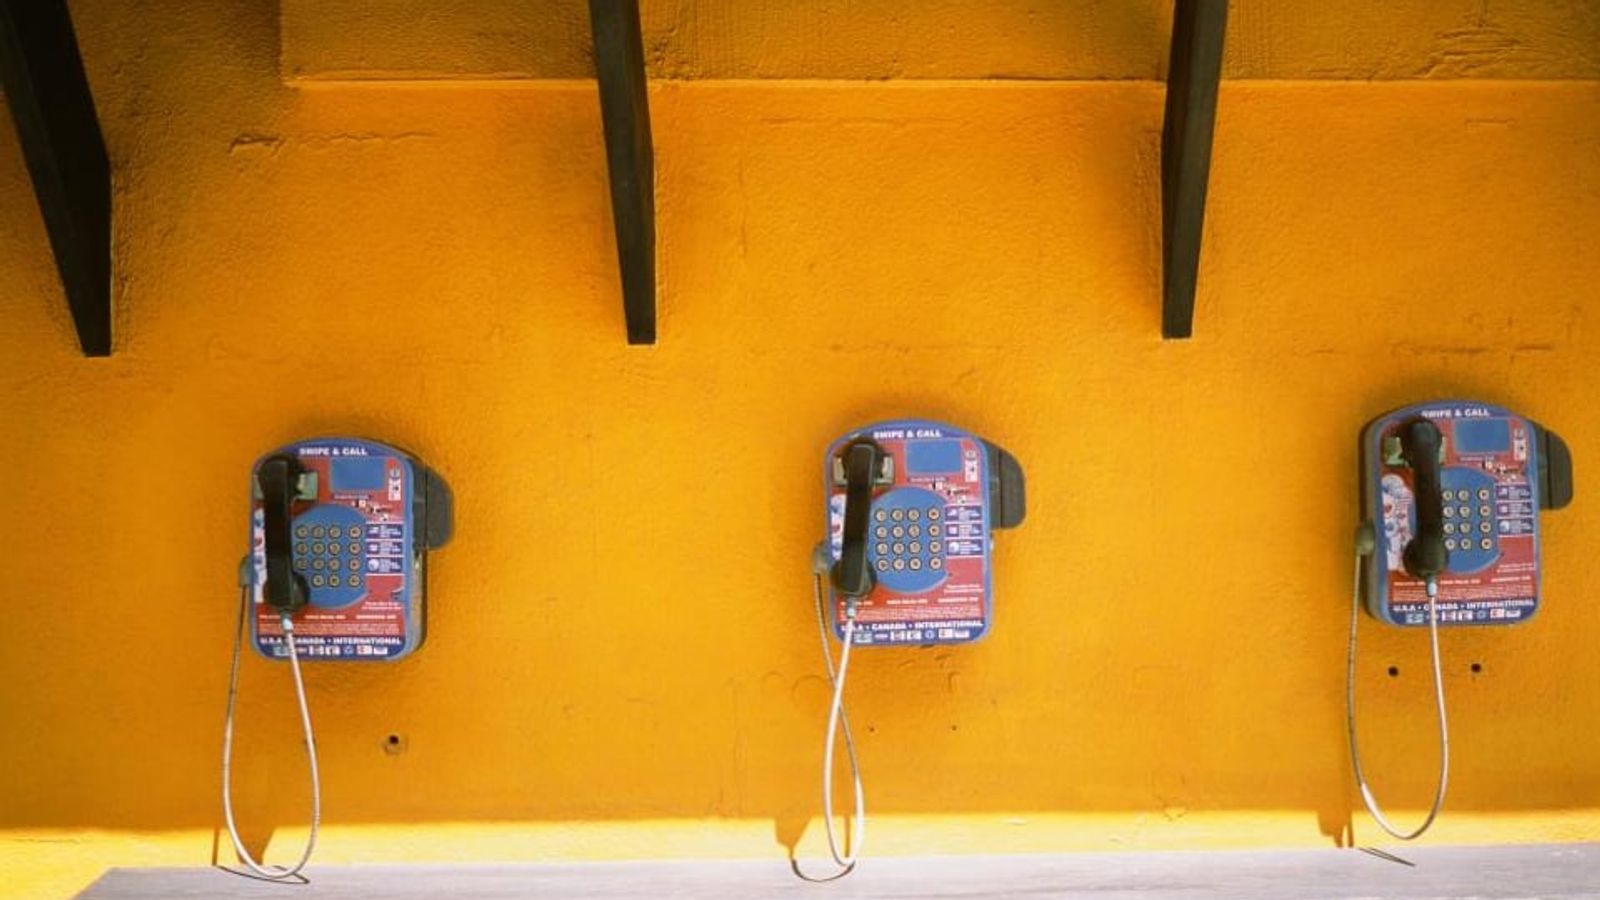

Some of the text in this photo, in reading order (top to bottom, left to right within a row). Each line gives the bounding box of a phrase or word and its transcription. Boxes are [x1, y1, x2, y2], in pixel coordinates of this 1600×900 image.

[1465, 408, 1489, 417] CALL
[873, 431, 905, 439] SWIPE
[916, 430, 942, 438] CALL
[342, 447, 367, 455] CALL
[1423, 602, 1458, 610] CNADA
[1466, 599, 1534, 609] INTERNATIONAL
[871, 622, 906, 630] CANADA
[914, 620, 983, 628] INTERNATIONAL
[333, 636, 401, 644] INTERNATIONAL
